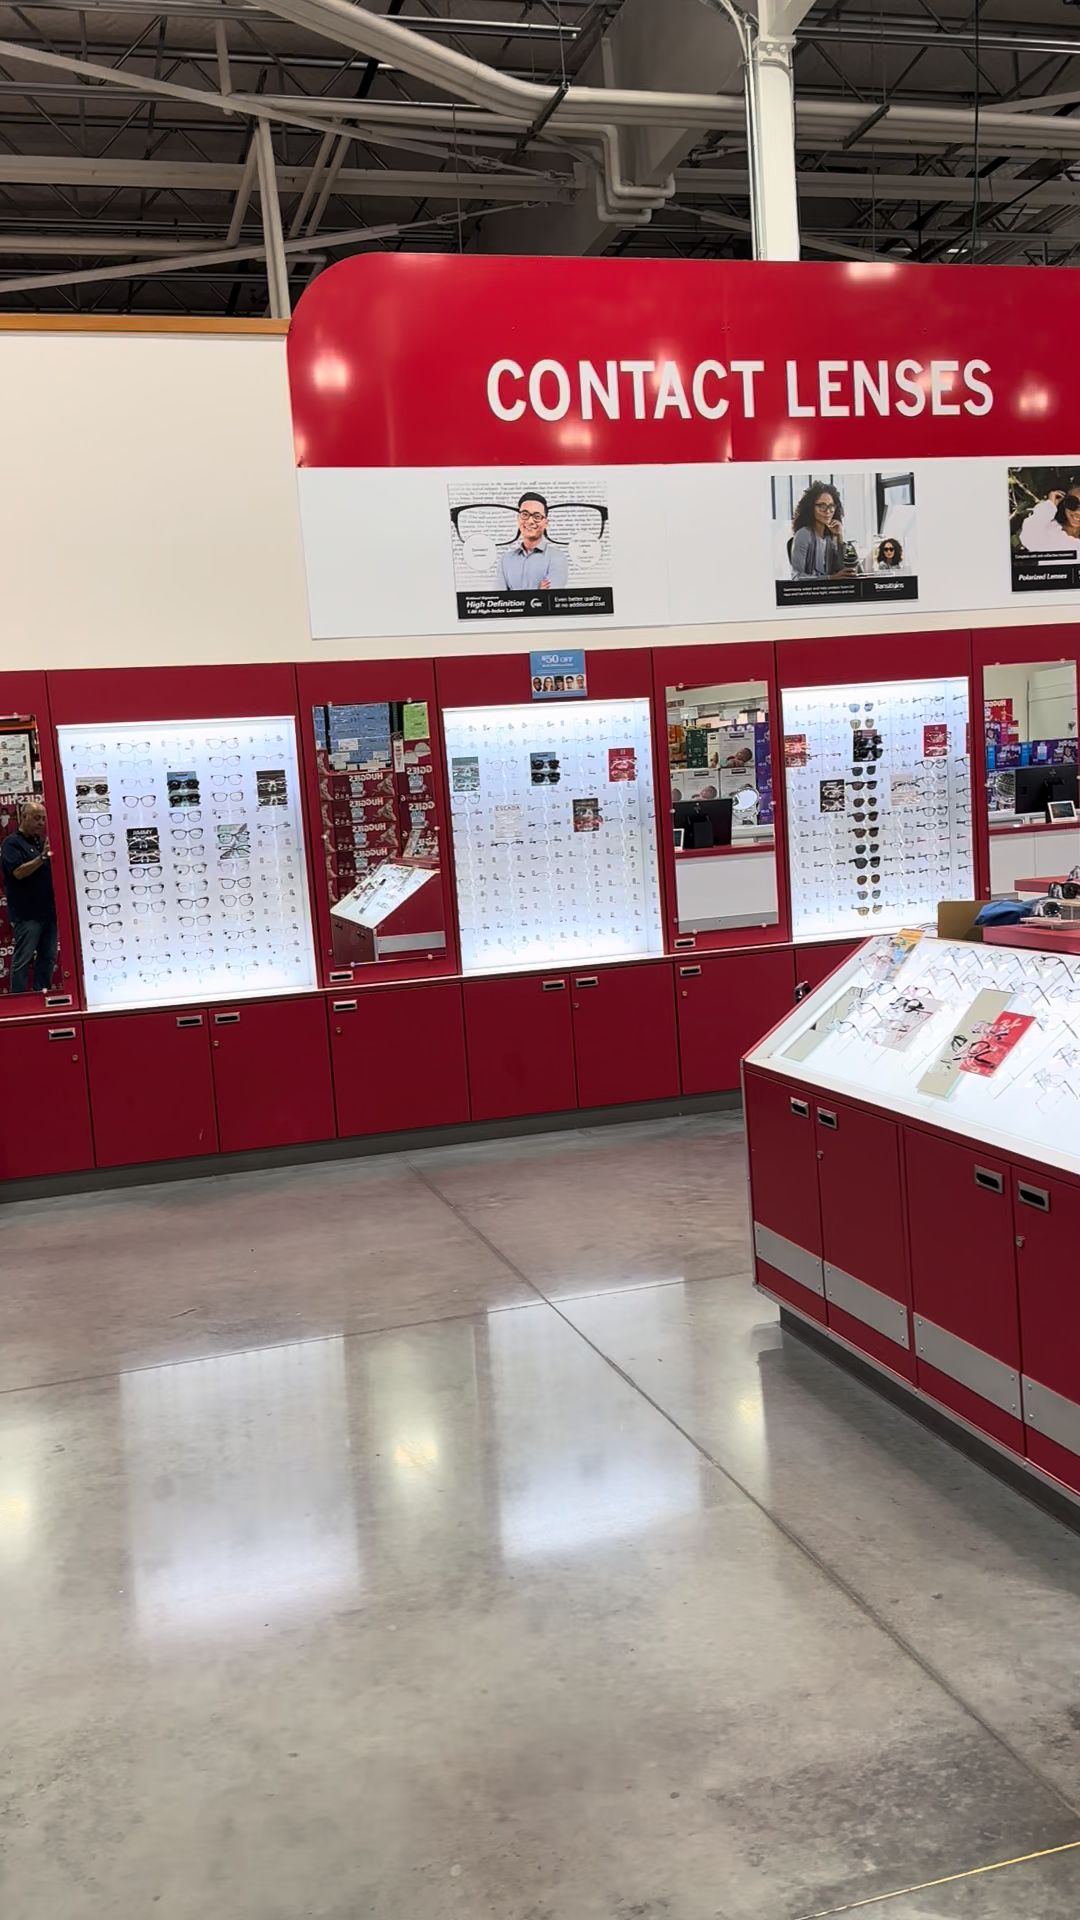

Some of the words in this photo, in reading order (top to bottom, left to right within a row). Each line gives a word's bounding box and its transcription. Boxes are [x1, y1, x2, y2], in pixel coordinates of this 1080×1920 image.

[487, 358, 765, 422] CONTACT
[786, 358, 994, 417] LENSES
[1018, 573, 1046, 581] Polarized
[874, 581, 904, 589] Transitions
[466, 601, 485, 609] High
[541, 654, 559, 664] $50
